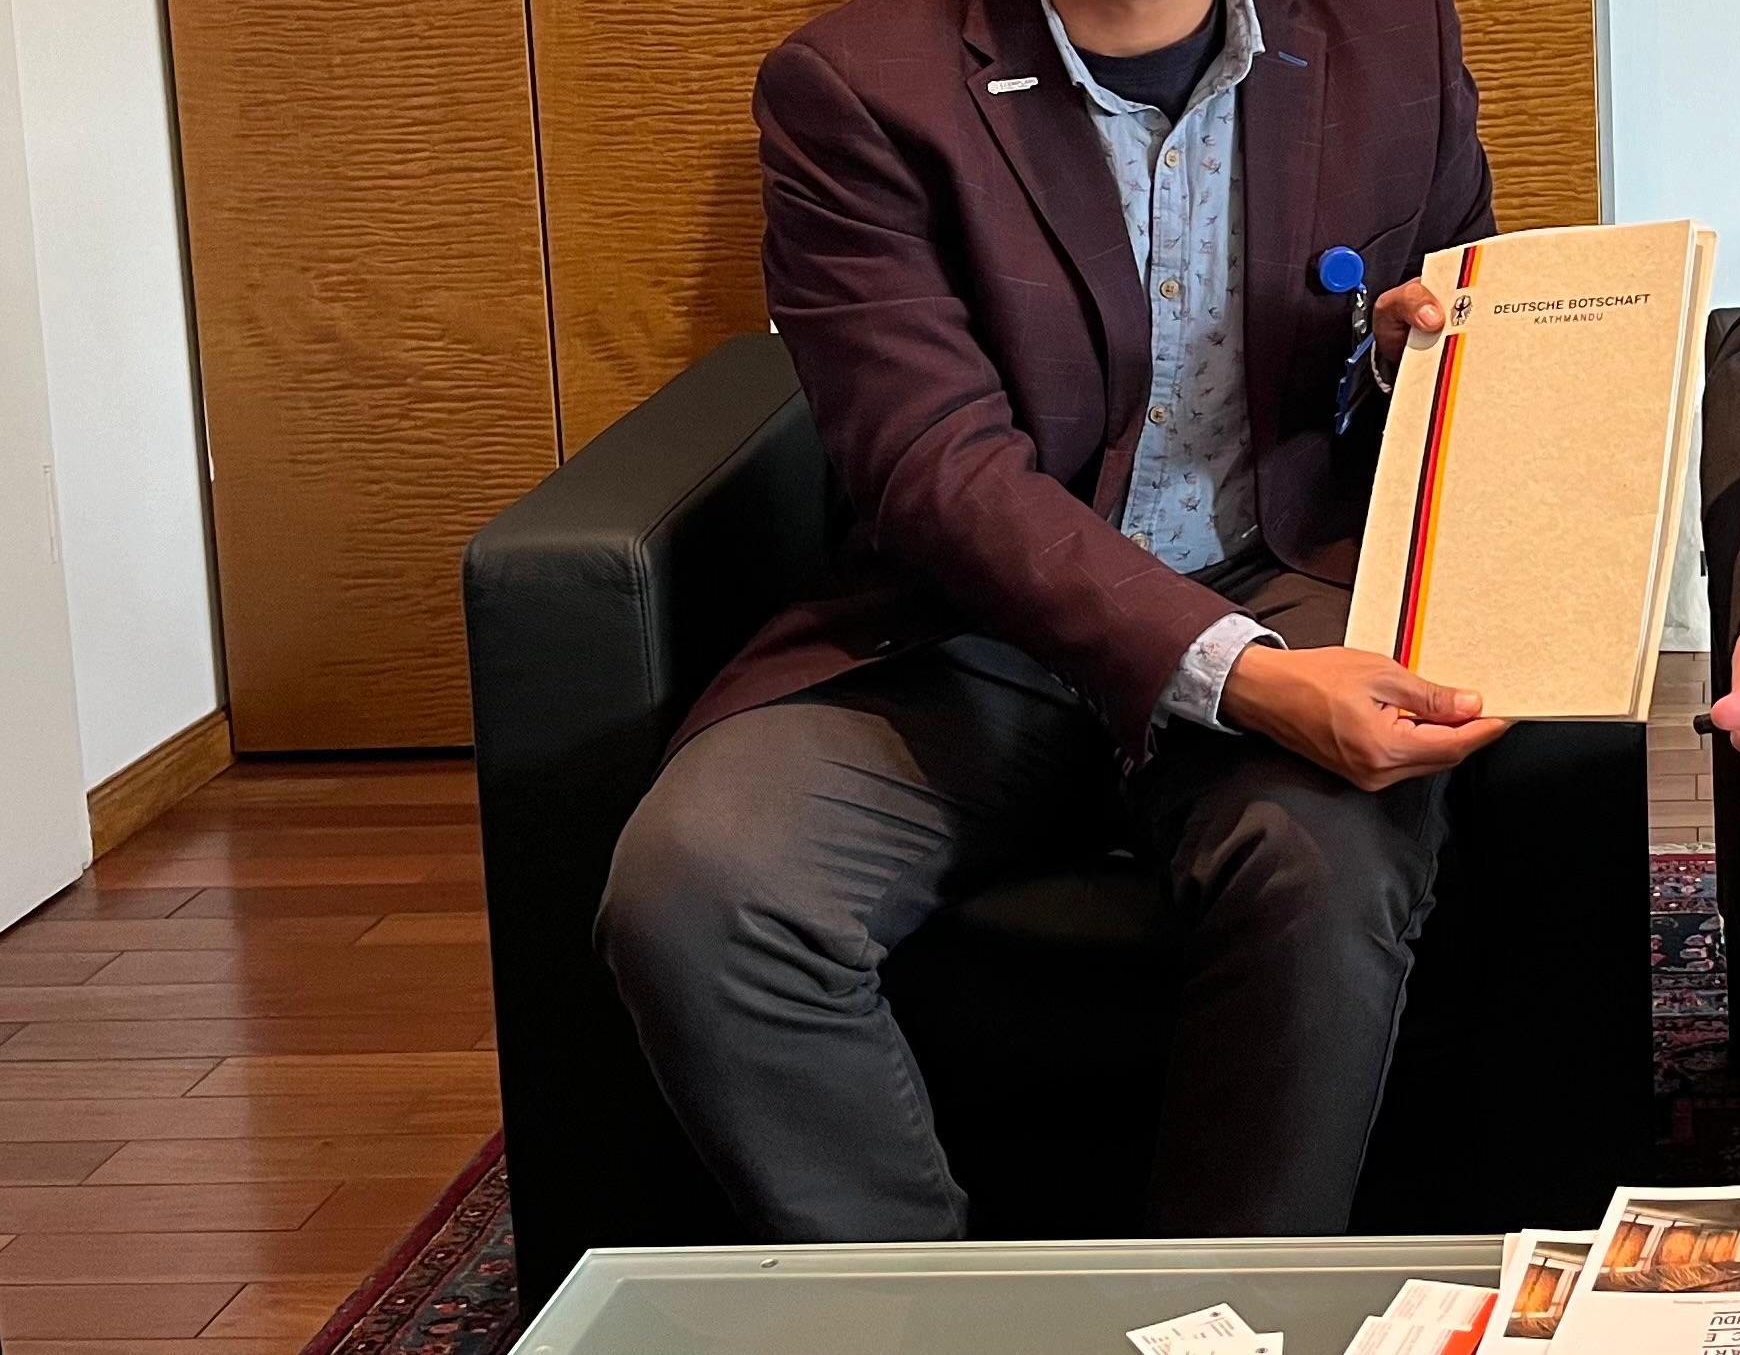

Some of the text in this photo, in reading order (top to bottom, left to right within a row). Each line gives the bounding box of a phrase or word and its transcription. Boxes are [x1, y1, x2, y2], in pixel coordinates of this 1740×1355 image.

[1493, 293, 1651, 314] DEUTSCHE BOTSCHAFT
[1534, 313, 1604, 325] KATHMANDU
